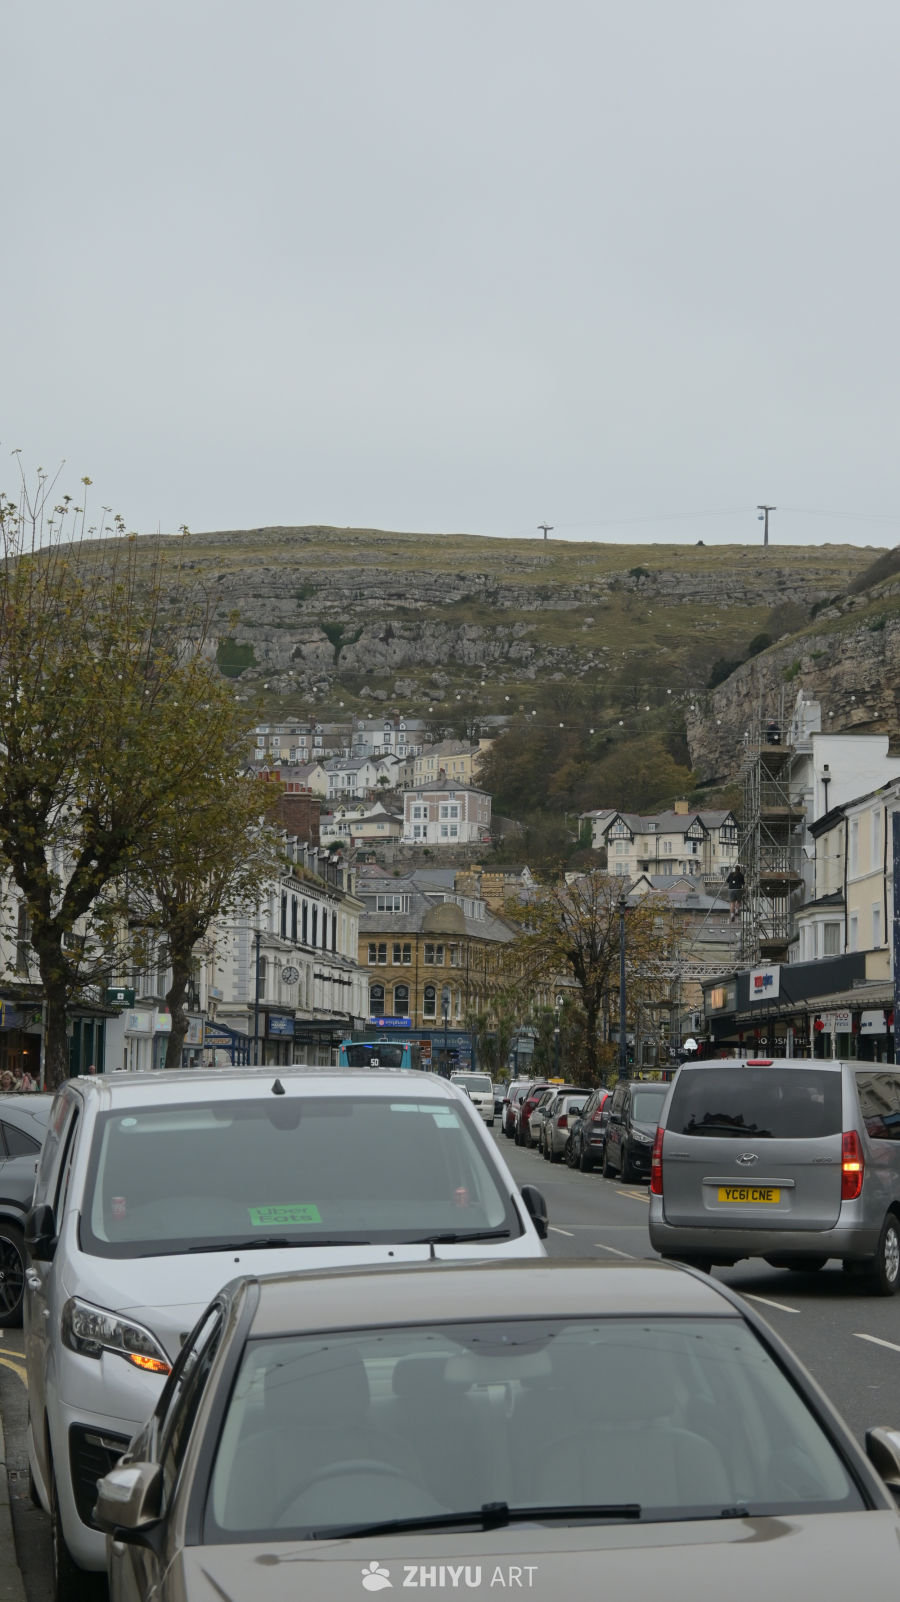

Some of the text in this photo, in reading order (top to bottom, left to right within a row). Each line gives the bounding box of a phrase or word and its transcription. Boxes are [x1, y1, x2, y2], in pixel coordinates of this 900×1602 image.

[725, 1189, 773, 1201] YC61 CNE
[258, 1214, 313, 1223] Eats
